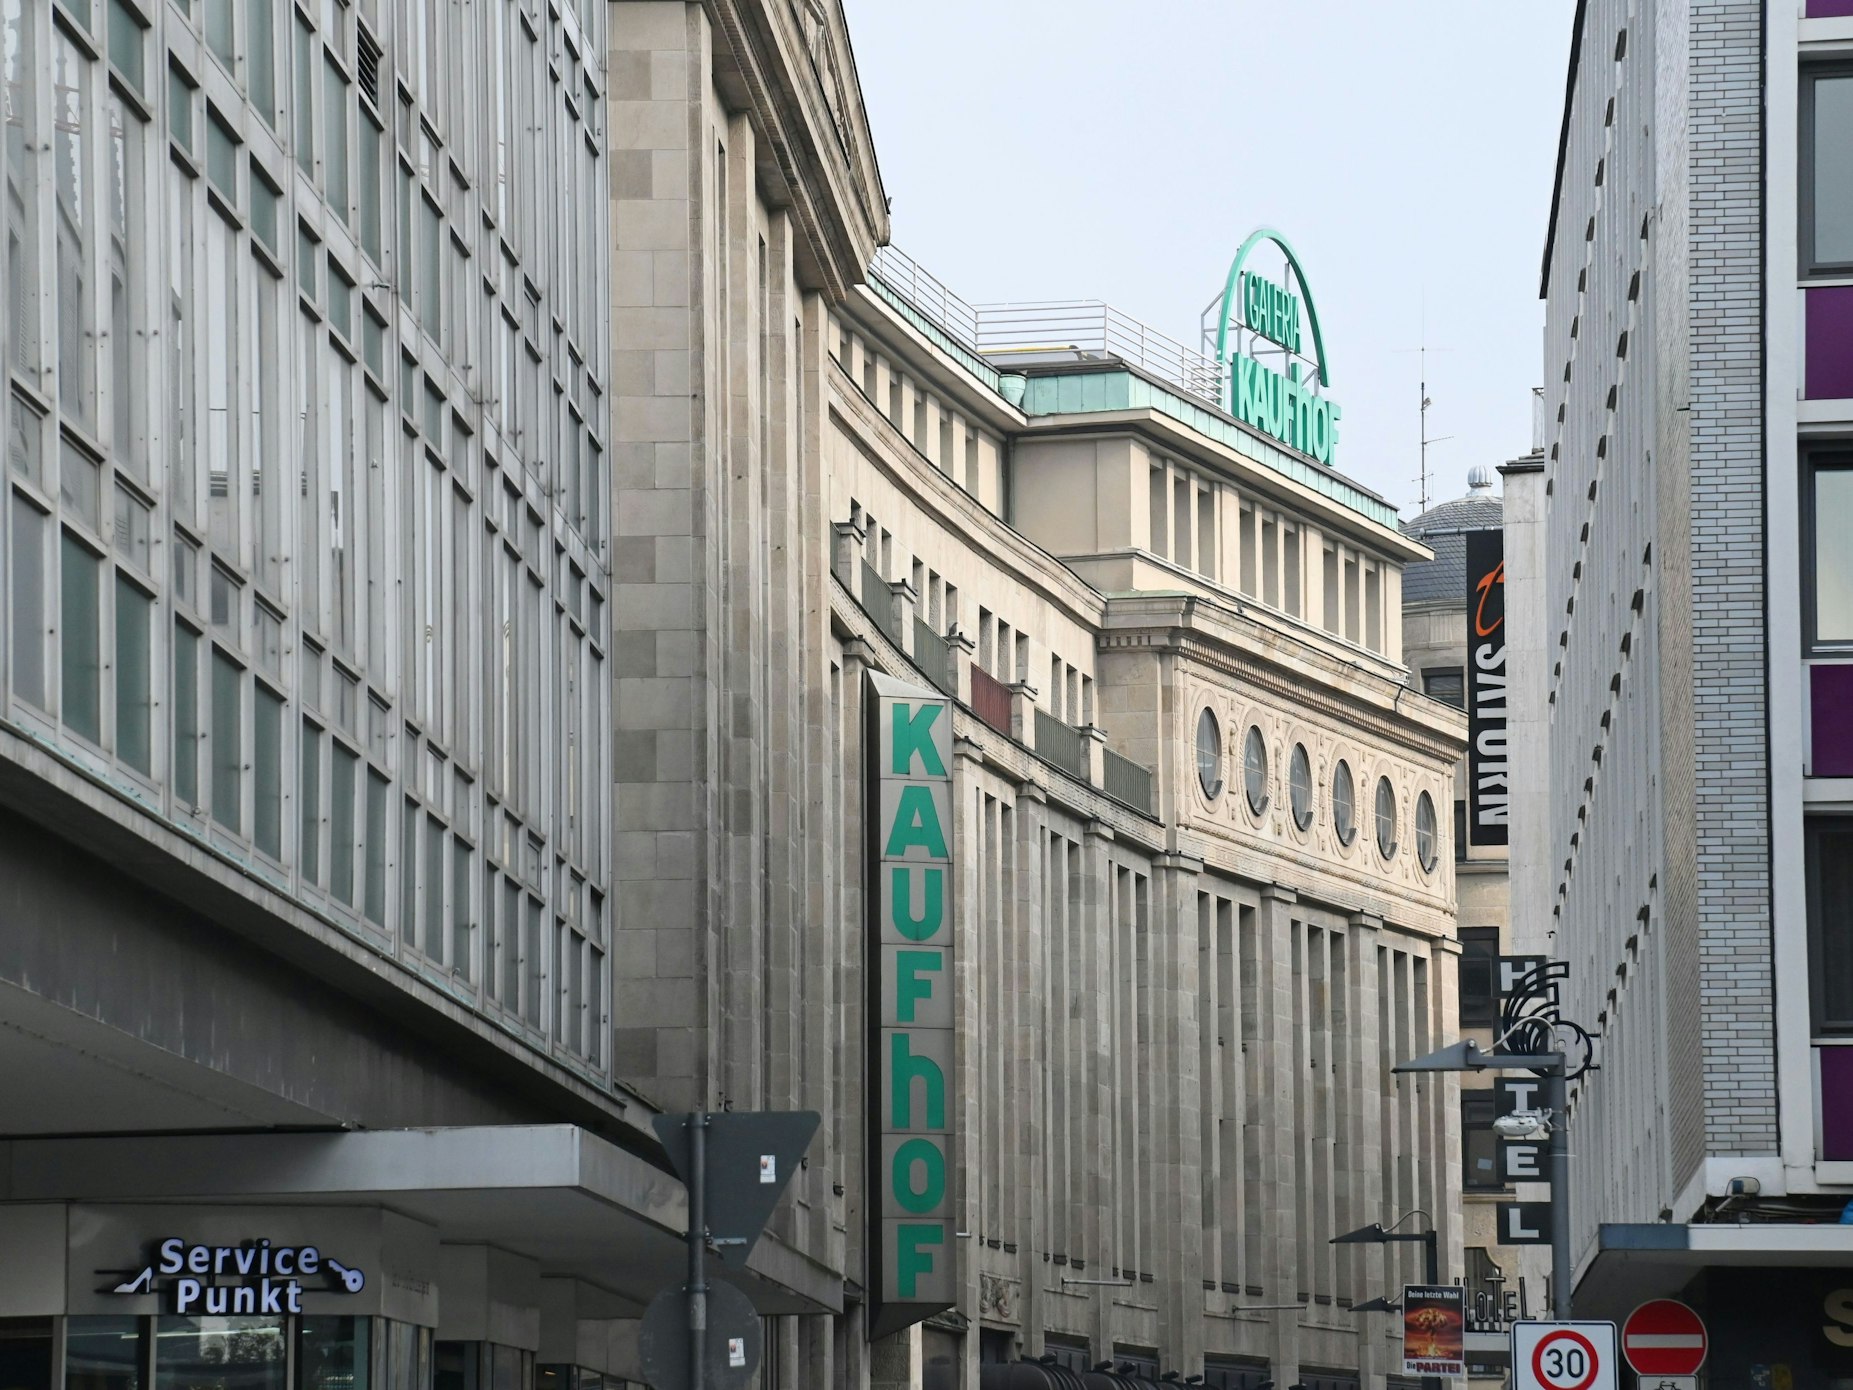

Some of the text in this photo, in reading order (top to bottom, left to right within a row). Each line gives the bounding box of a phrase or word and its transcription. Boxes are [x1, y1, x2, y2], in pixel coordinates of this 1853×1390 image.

[1244, 270, 1301, 355] GALERIA
[159, 1237, 320, 1275] Service
[176, 1277, 303, 1315] Punkt
[1408, 1290, 1459, 1300] Deine letzte Wahl
[1406, 1361, 1461, 1374] Die PARTEI
[1546, 1348, 1584, 1378] 30
